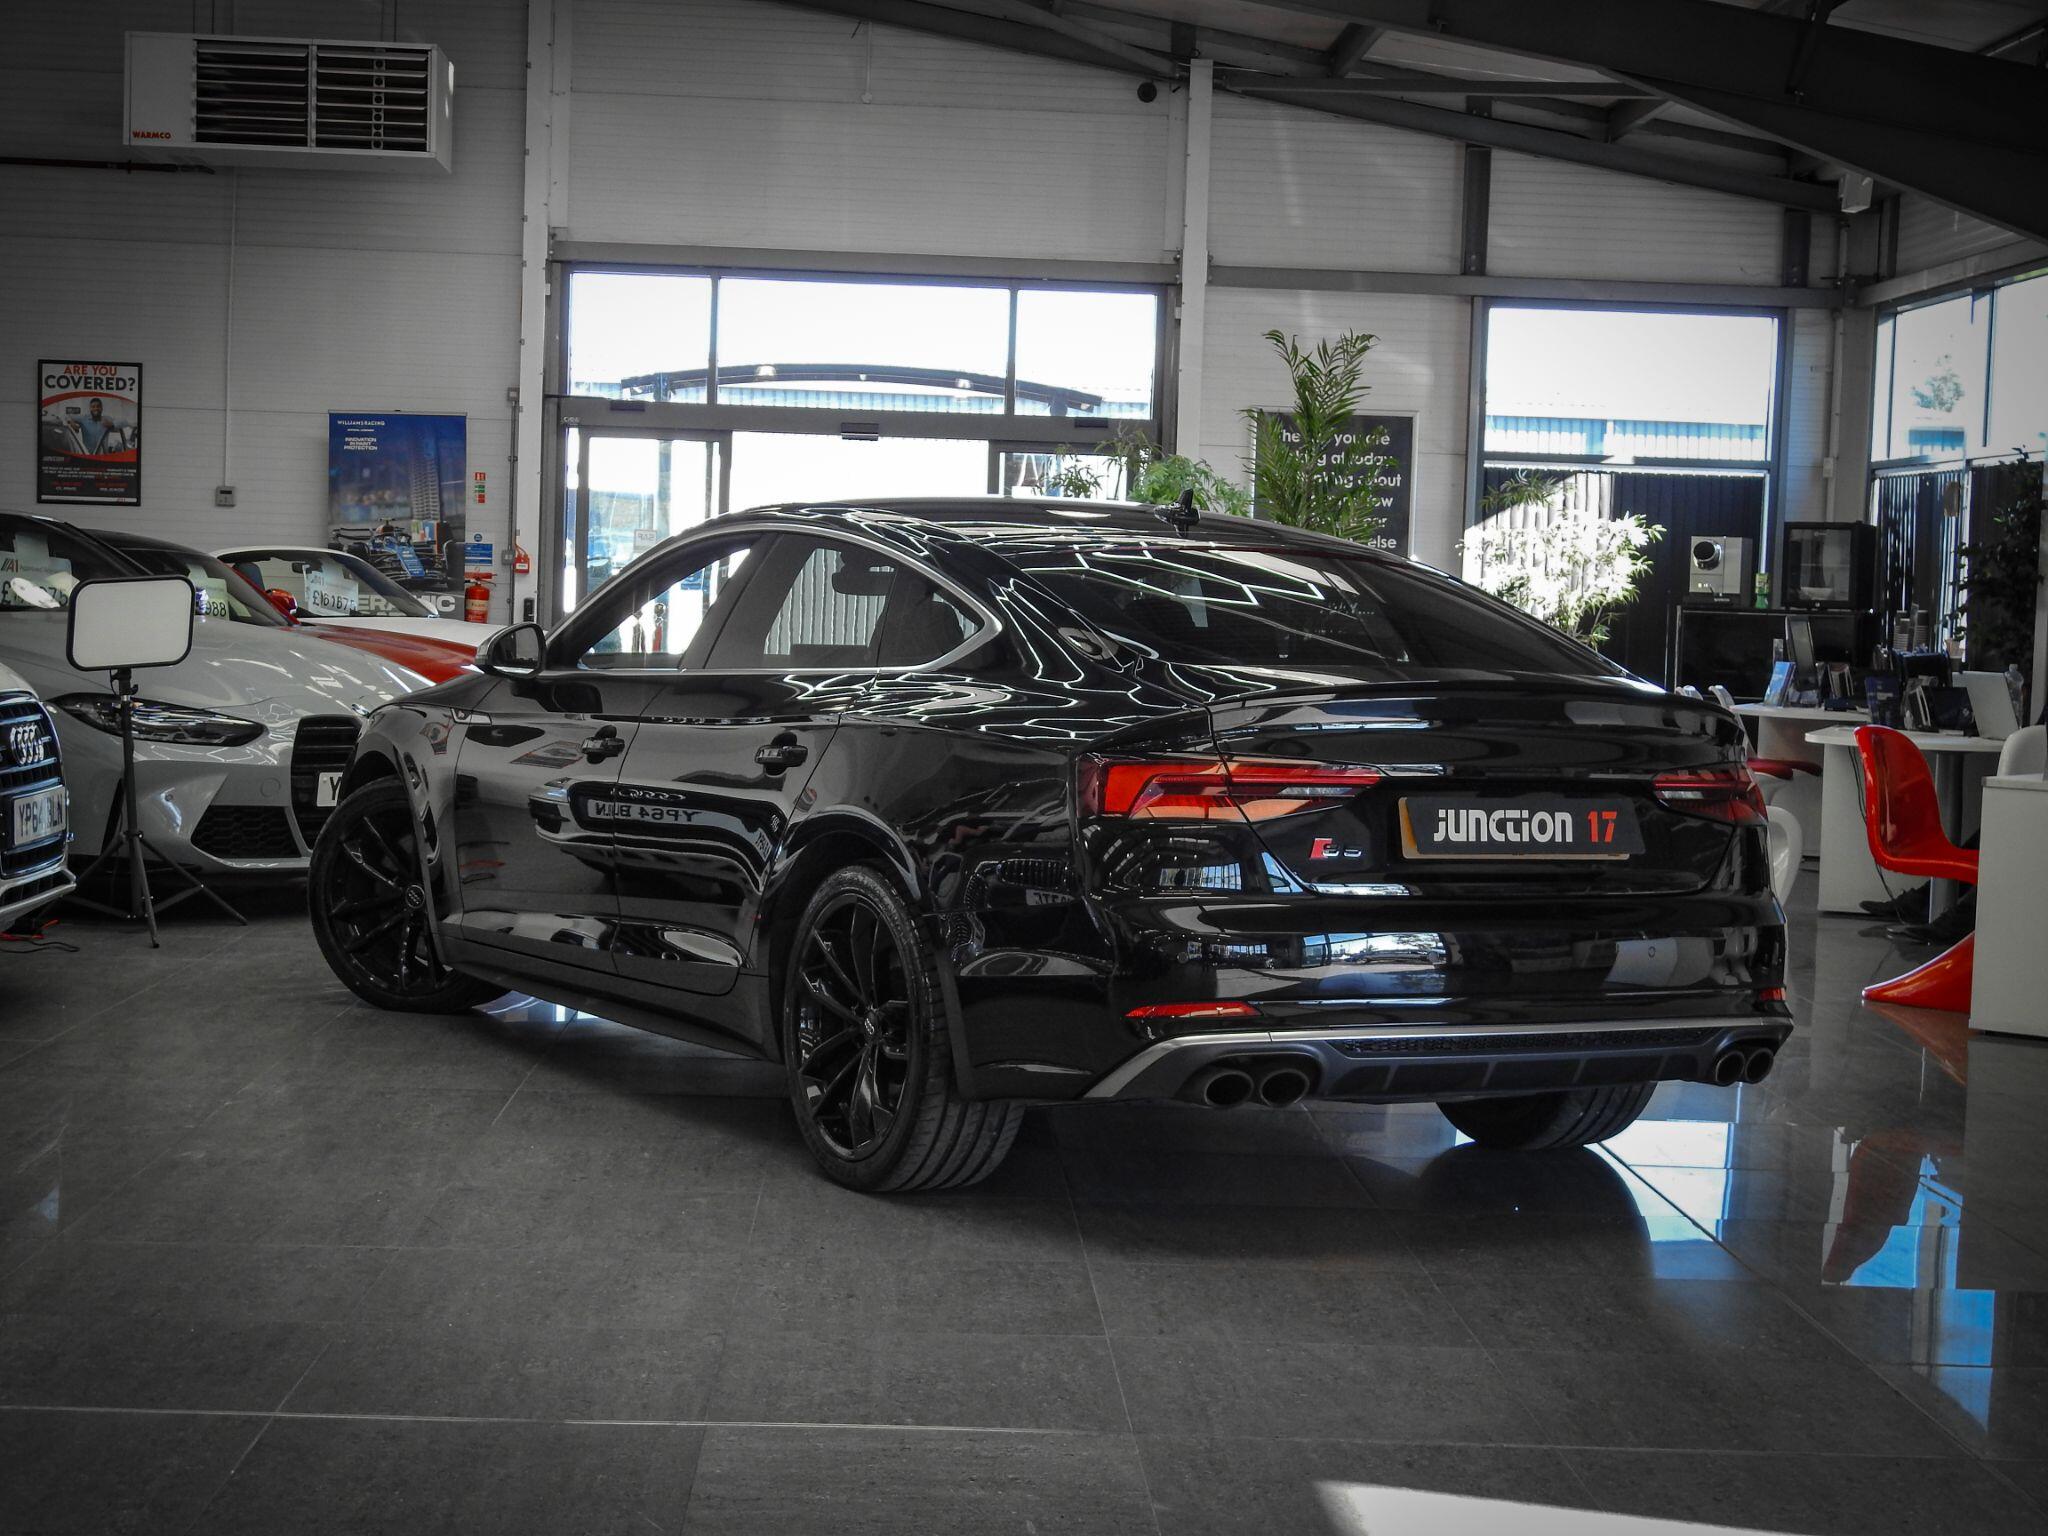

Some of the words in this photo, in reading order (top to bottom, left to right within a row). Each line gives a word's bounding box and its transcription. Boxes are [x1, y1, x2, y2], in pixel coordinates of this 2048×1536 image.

[132, 131, 171, 139] WARMCO
[64, 365, 88, 376] ARE
[92, 366, 118, 377] YOU
[44, 374, 136, 392] COVERED?
[1587, 811, 1618, 843] 17
